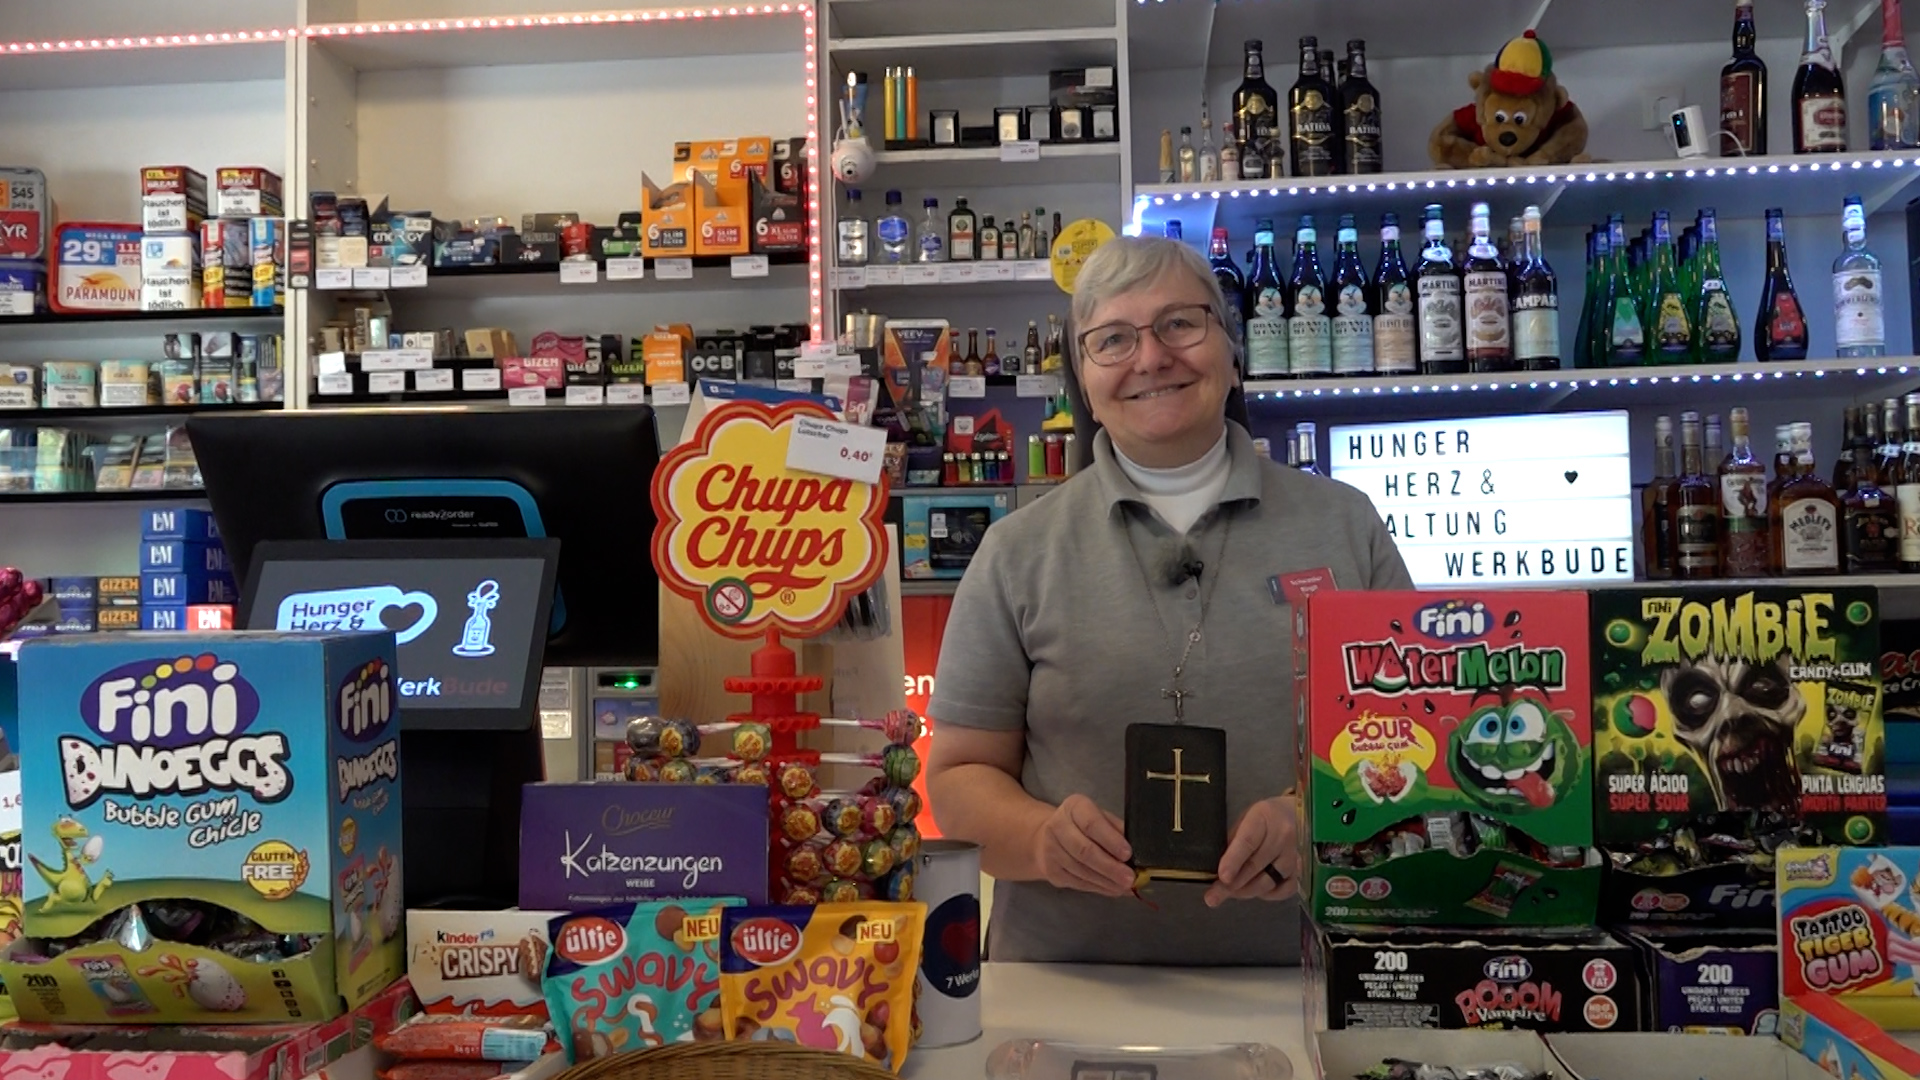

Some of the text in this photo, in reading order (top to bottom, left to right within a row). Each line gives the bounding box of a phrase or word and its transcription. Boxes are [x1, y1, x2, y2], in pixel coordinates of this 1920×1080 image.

[691, 355, 734, 371] OCB
[1349, 429, 1470, 460] HUNGER
[696, 464, 853, 526] Chupa
[1386, 468, 1495, 497] HERZ &
[1385, 508, 1507, 538] ALTUNG
[686, 516, 847, 596] Chups
[1445, 547, 1628, 577] WERKBUDE
[100, 578, 139, 592] GIZEH
[99, 610, 138, 624] GIZEH
[292, 599, 375, 621] Hunger
[1420, 602, 1485, 637] Fini
[98, 664, 238, 742] Fini
[1348, 717, 1416, 743] SOUR
[1609, 774, 1645, 794] SUPER
[1801, 774, 1885, 795] PINTA LENGUAS
[104, 796, 238, 829] Bubble Gum
[1609, 794, 1690, 812] SUPER SOUR
[189, 811, 261, 848] Chicle
[251, 851, 296, 863] GLUTEN
[561, 828, 723, 890] Katzenzungen
[241, 864, 294, 881] FREE
[1708, 884, 1776, 909] Fin
[686, 918, 719, 939] NEU
[860, 924, 892, 941] NEU
[1796, 909, 1864, 938] TATTOO
[566, 924, 617, 954] ültje
[743, 924, 793, 952] ültje
[1800, 927, 1870, 961] TIGER
[443, 946, 519, 978] CRISPY
[1374, 951, 1408, 971] 200
[1489, 958, 1526, 979] Fini
[1697, 964, 1733, 985] 200
[1806, 948, 1879, 987] GUM
